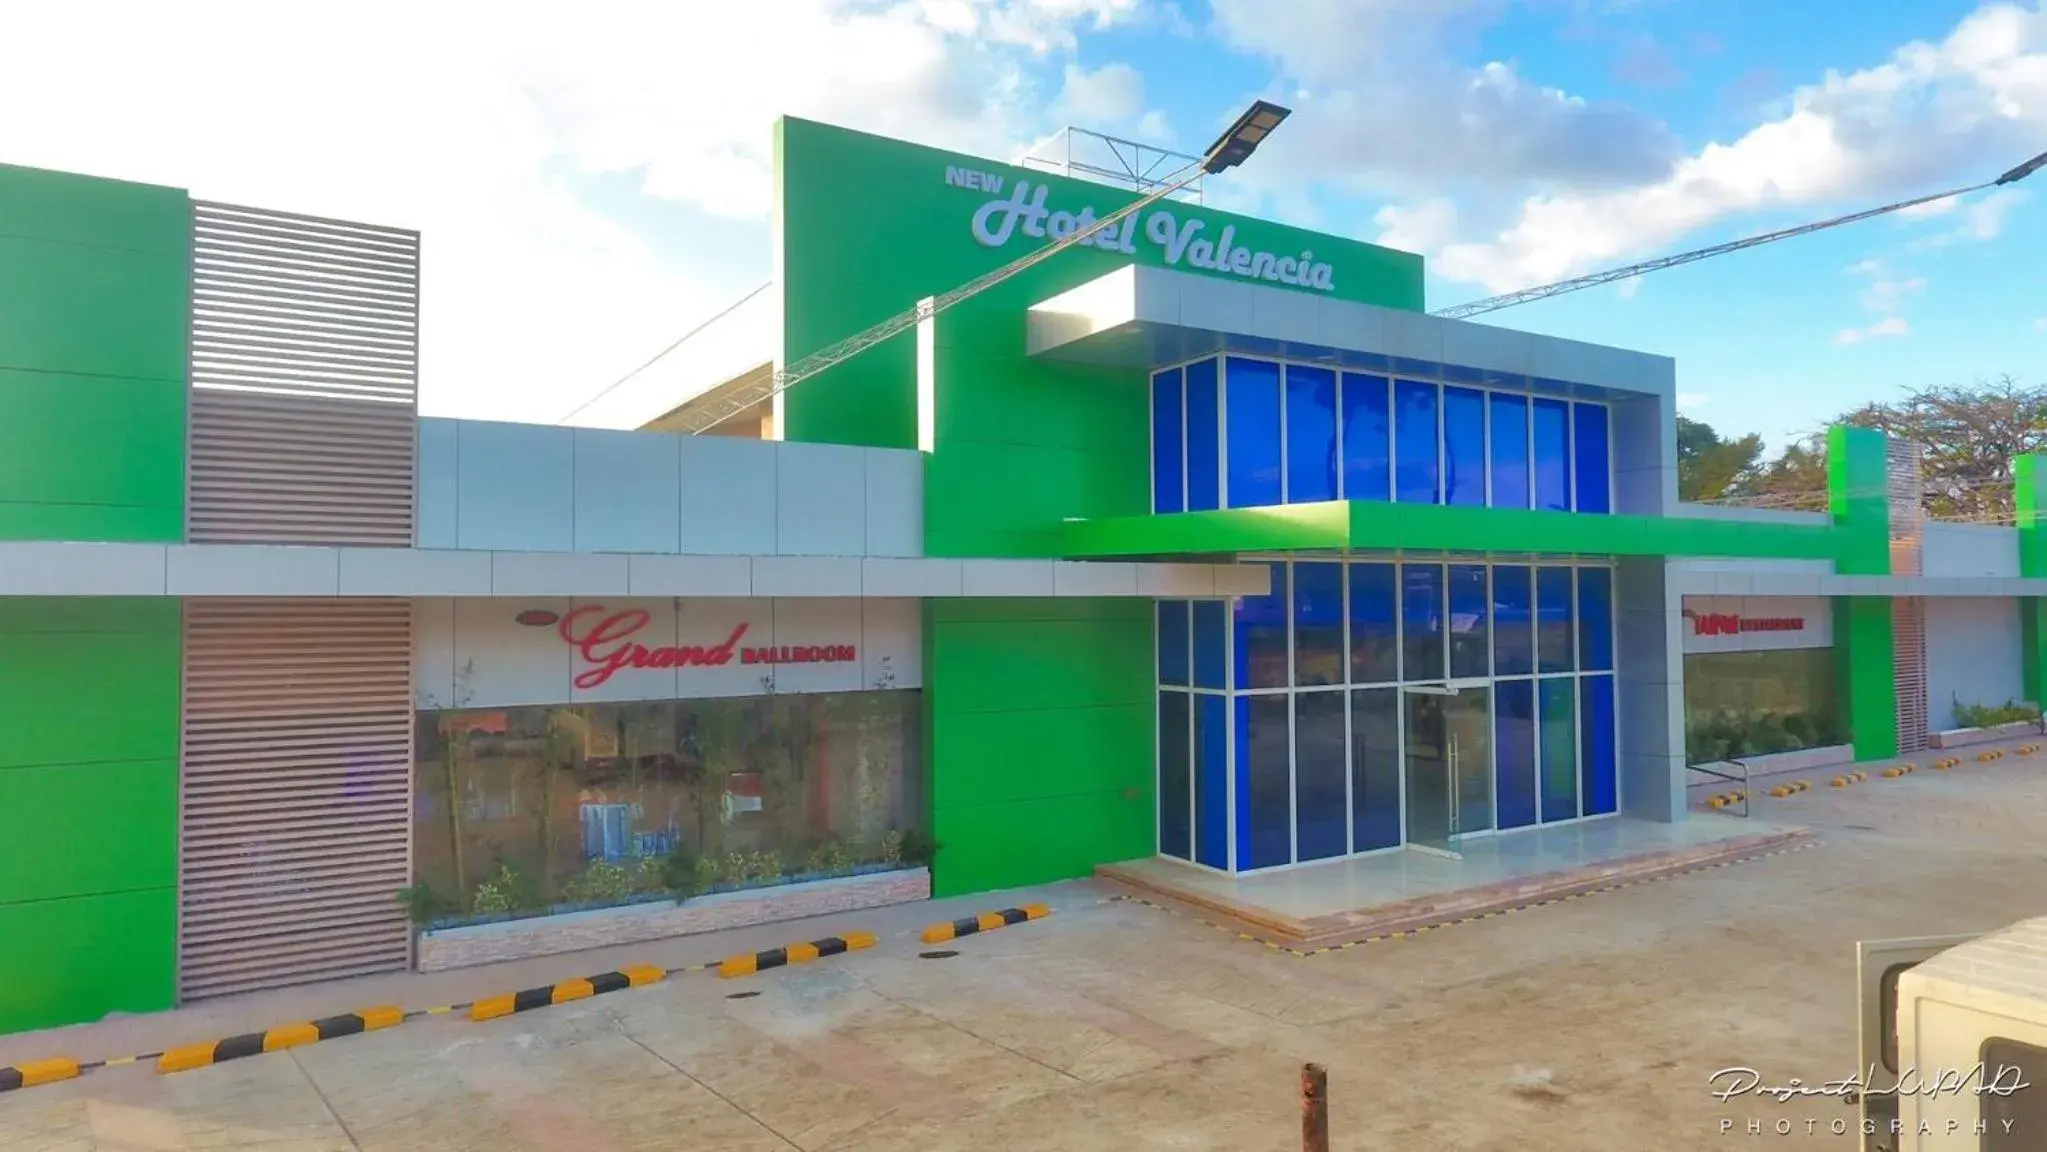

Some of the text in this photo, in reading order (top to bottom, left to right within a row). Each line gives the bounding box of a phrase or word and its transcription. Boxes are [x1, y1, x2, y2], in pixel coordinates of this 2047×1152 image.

[945, 167, 1004, 193] NEW
[972, 180, 1334, 290] Hotel Valencia
[558, 606, 748, 689] Grand
